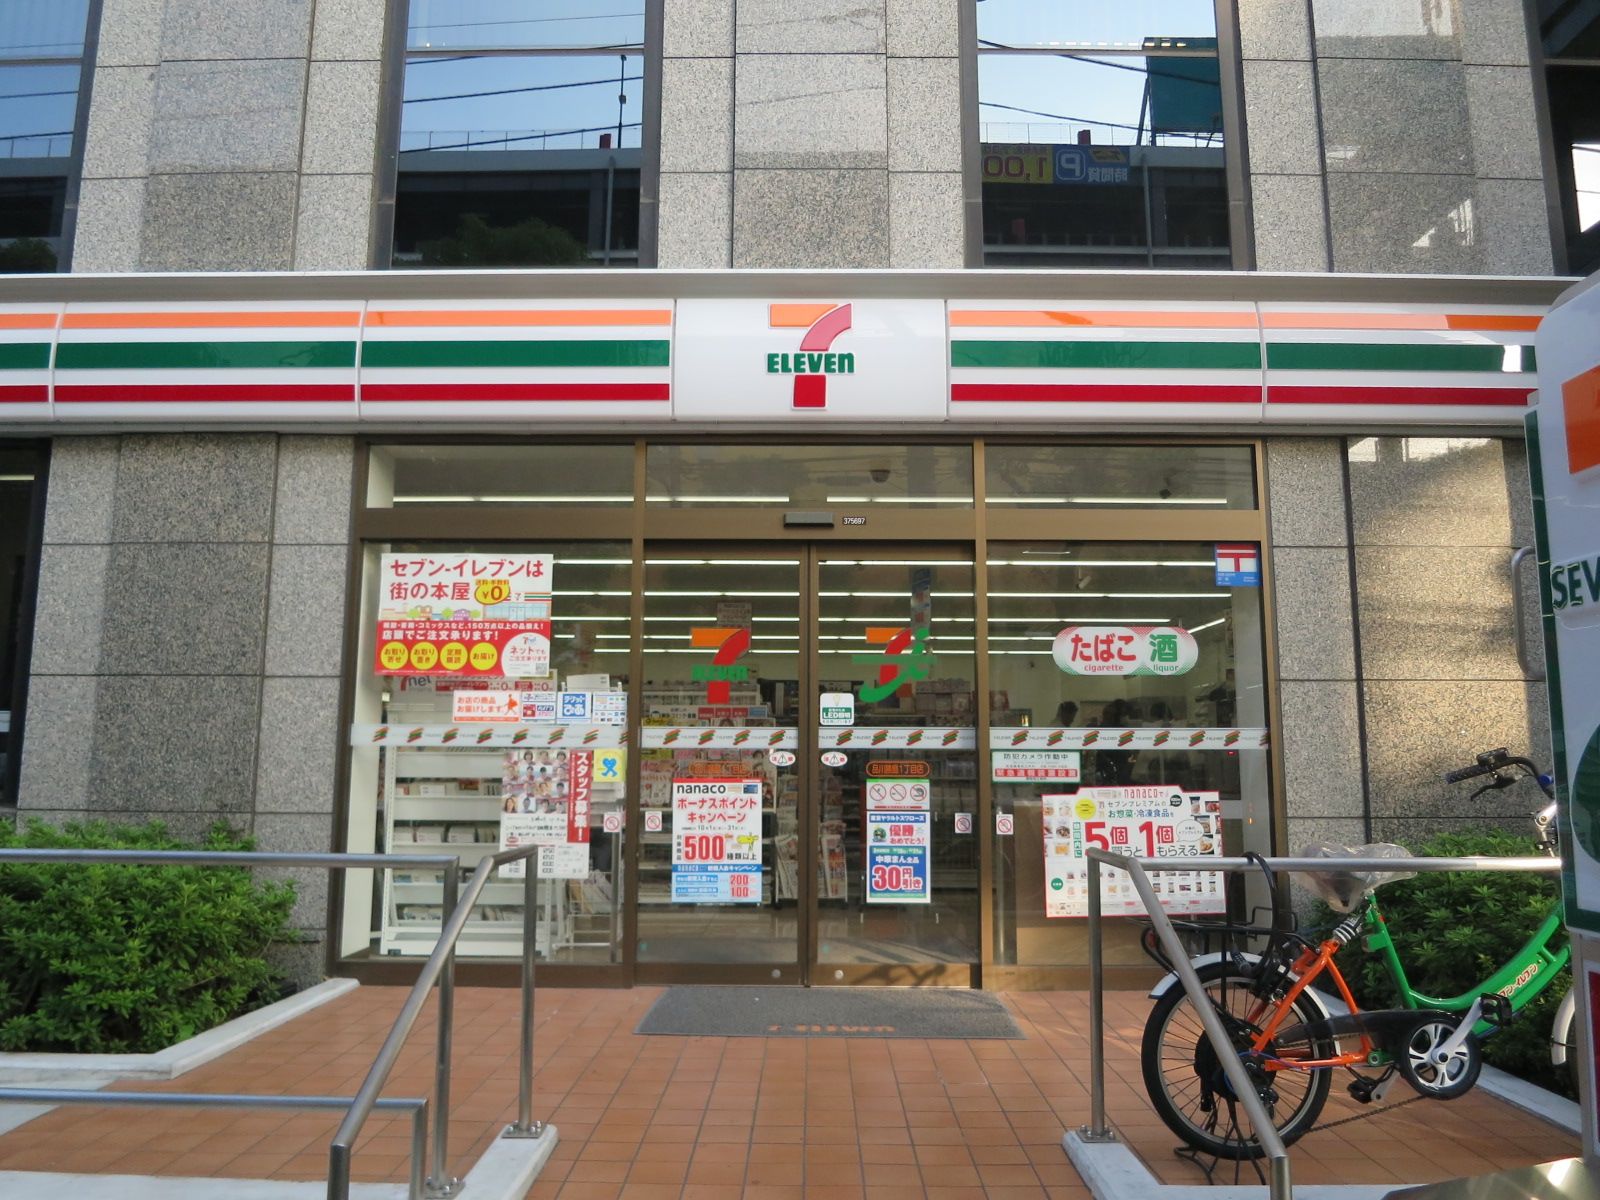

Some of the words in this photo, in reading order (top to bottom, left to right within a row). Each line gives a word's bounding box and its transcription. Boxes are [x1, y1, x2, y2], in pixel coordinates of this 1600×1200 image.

[390, 559, 544, 578] セブン-イレブンは
[1551, 556, 1600, 610] SEV
[390, 582, 471, 601] 街の本屋
[1071, 633, 1137, 662] たばこ
[1149, 633, 1178, 662] 酒
[1084, 663, 1124, 672] cigarette
[1153, 663, 1179, 672] liquor
[676, 784, 727, 795] nanaco
[677, 797, 758, 810] ボーナスポイント
[687, 812, 747, 824] キャンペーン
[1138, 821, 1175, 858] 1個
[684, 834, 725, 861] 500
[1156, 845, 1199, 857] もらえる
[730, 874, 749, 885] 200
[730, 886, 749, 897] 100
